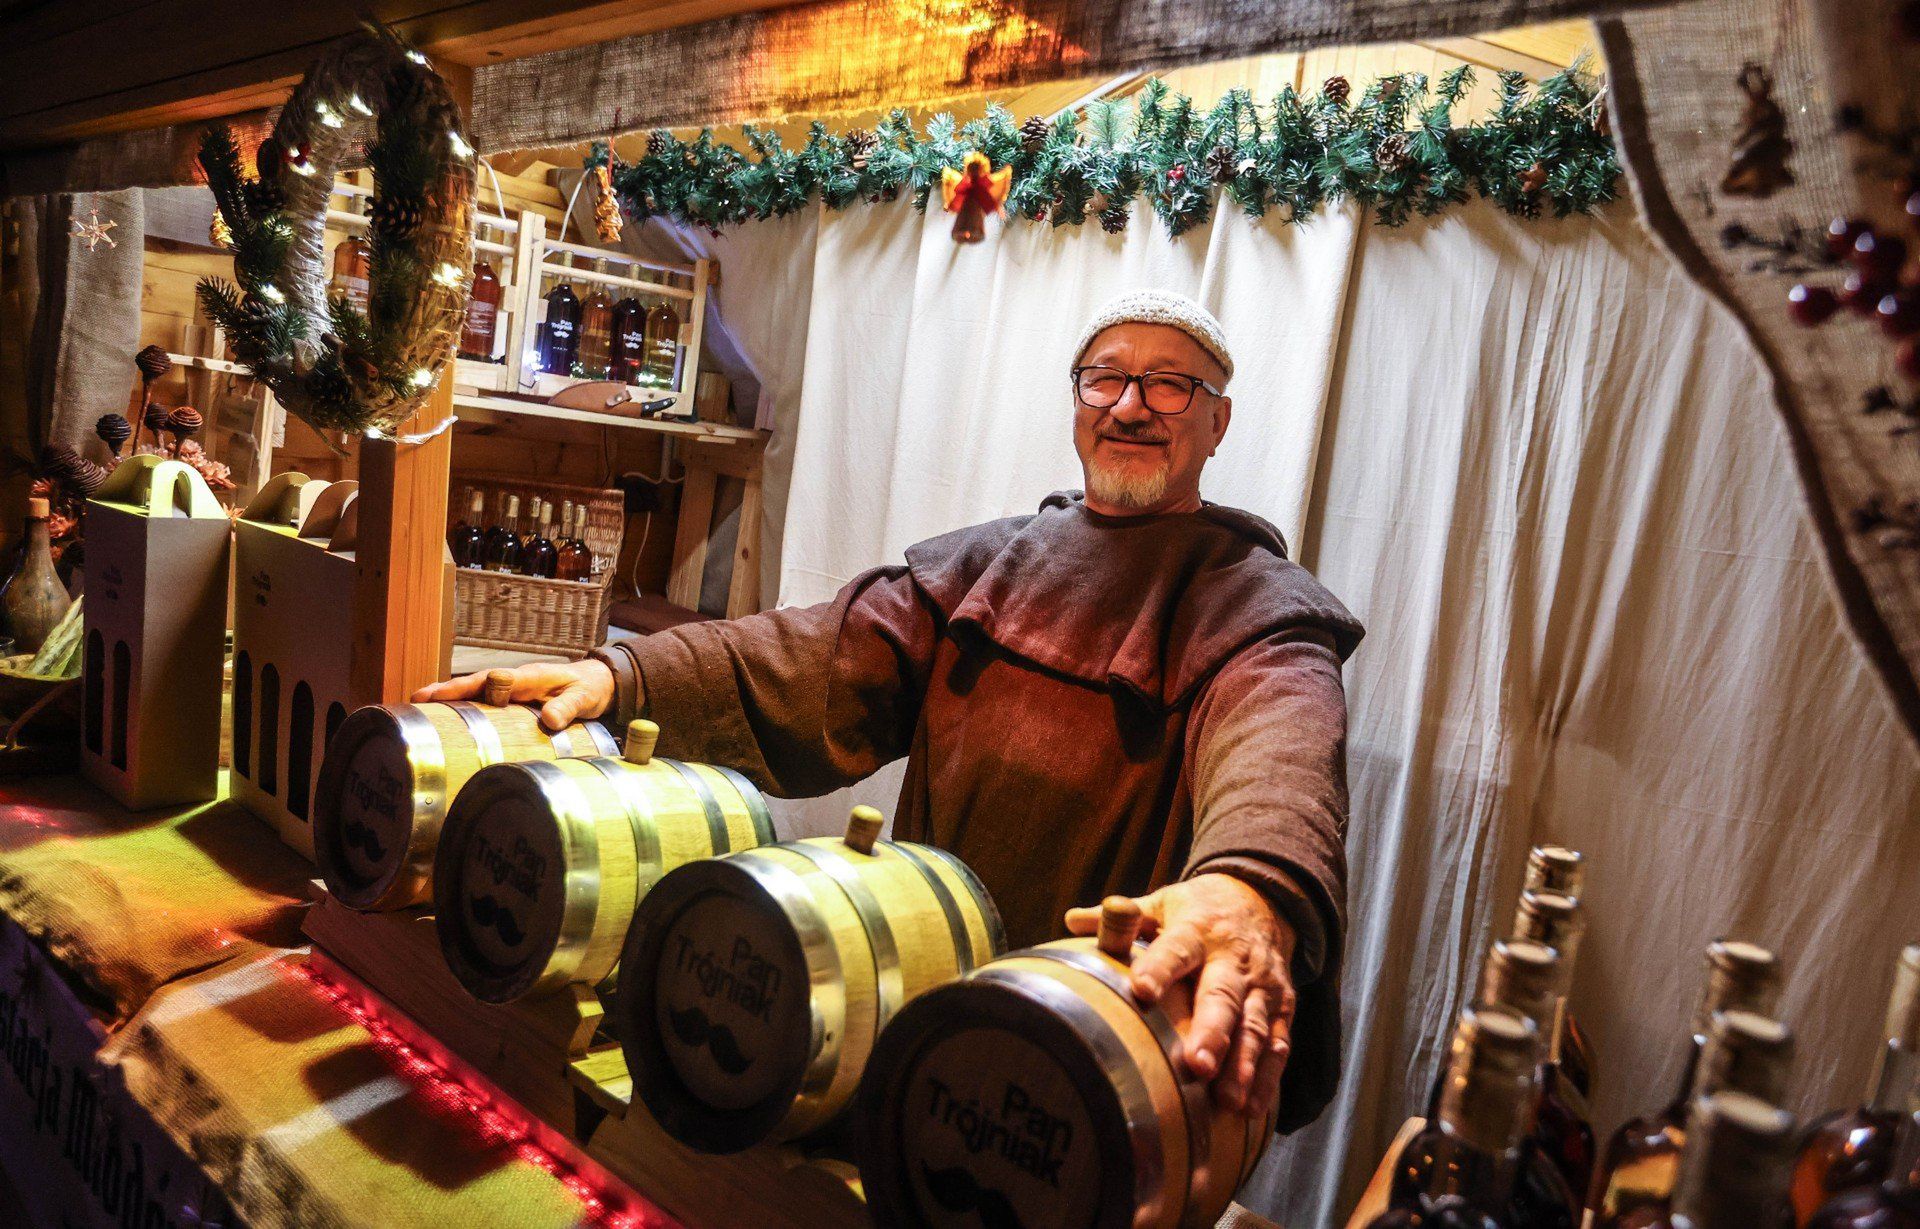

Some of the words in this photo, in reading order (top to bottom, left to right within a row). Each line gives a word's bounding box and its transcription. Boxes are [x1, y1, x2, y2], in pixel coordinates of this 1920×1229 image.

[676, 933, 775, 1025] Trójniak
[730, 934, 781, 994] Pan
[927, 1076, 1064, 1191] Trójniak
[1001, 1081, 1073, 1154] Pan
